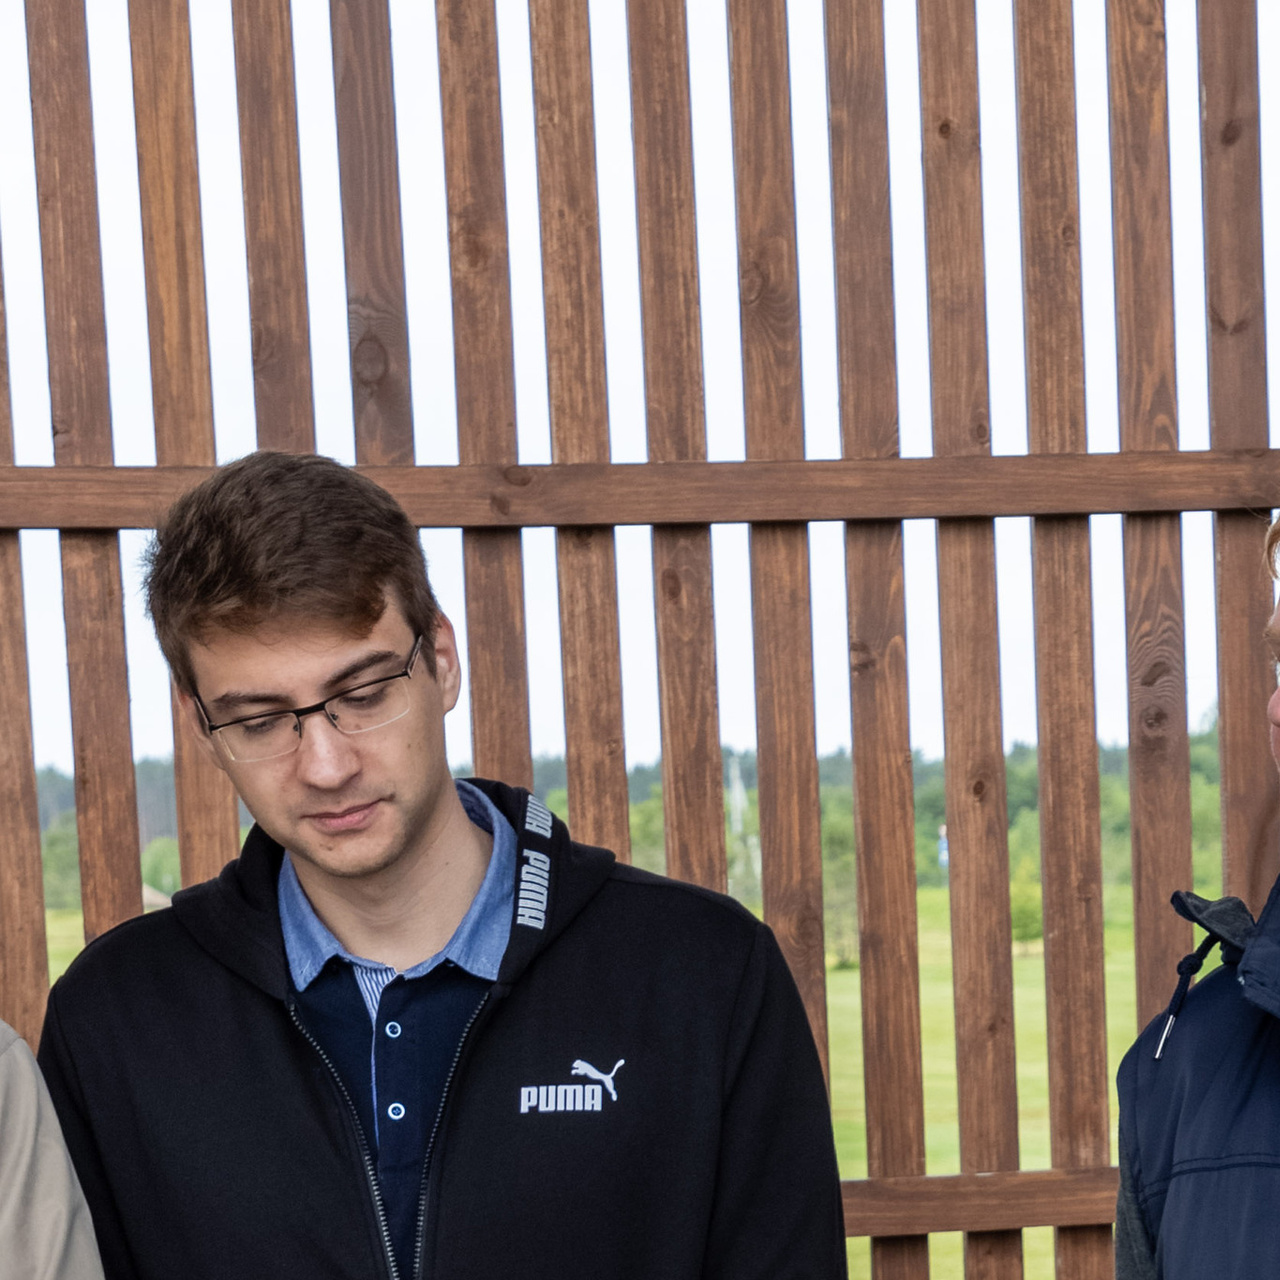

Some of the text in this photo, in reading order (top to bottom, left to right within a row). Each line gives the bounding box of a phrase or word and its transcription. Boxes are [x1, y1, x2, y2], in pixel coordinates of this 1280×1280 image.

[524, 793, 552, 839] UMA
[517, 848, 551, 930] PUMA
[520, 1084, 603, 1113] PUMA
